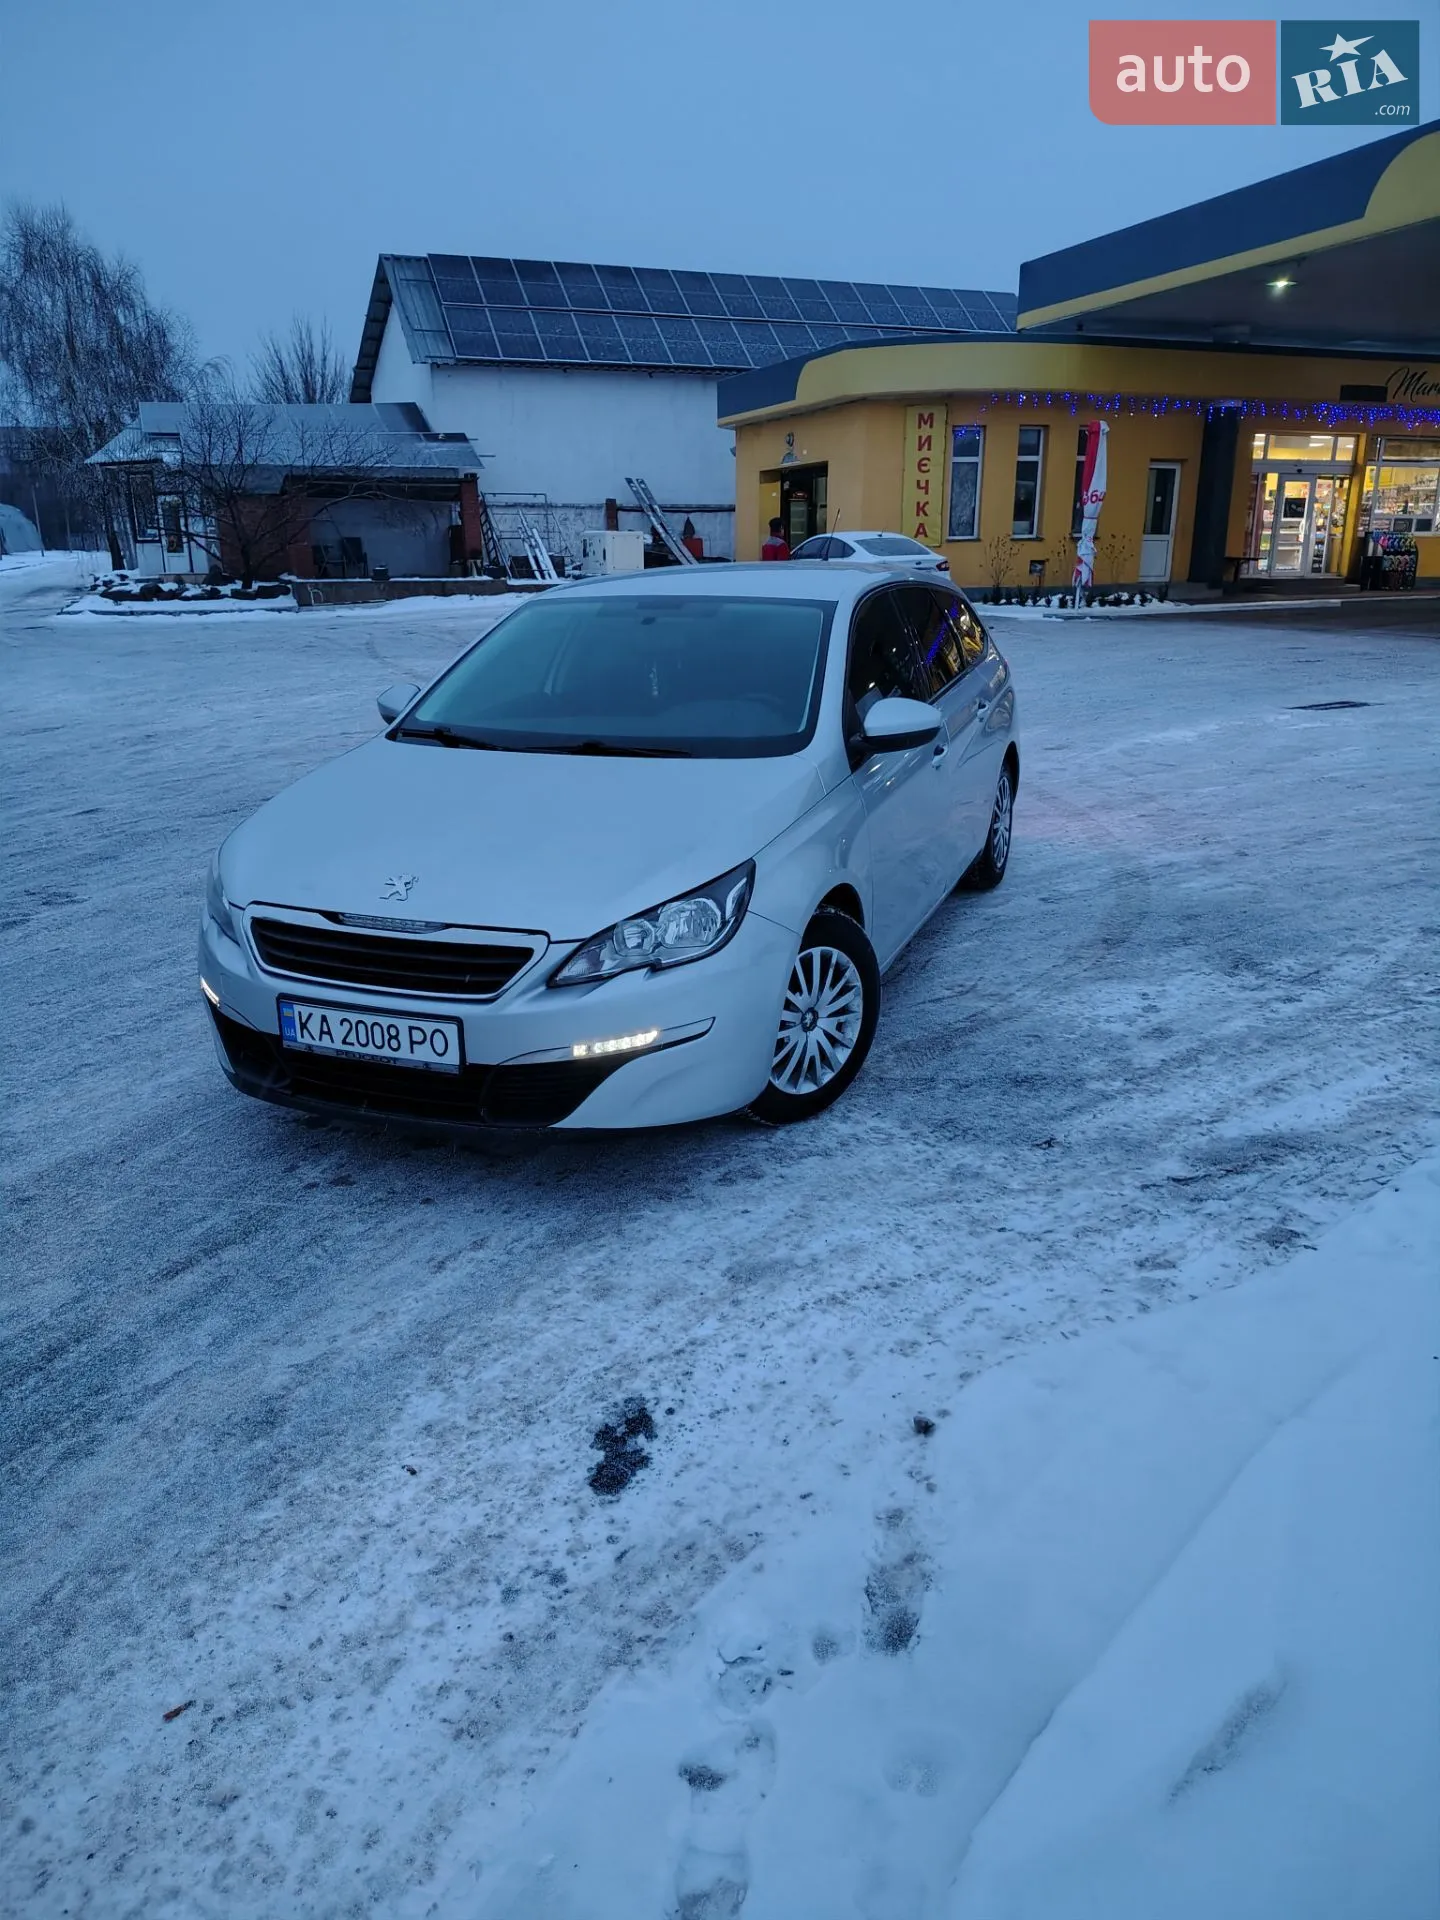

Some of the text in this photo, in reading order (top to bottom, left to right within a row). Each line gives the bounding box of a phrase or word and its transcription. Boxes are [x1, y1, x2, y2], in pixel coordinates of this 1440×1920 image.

[914, 412, 934, 538] МИЄЧКА
[284, 1026, 296, 1038] UA
[298, 1010, 449, 1057] KA 2008 PO
